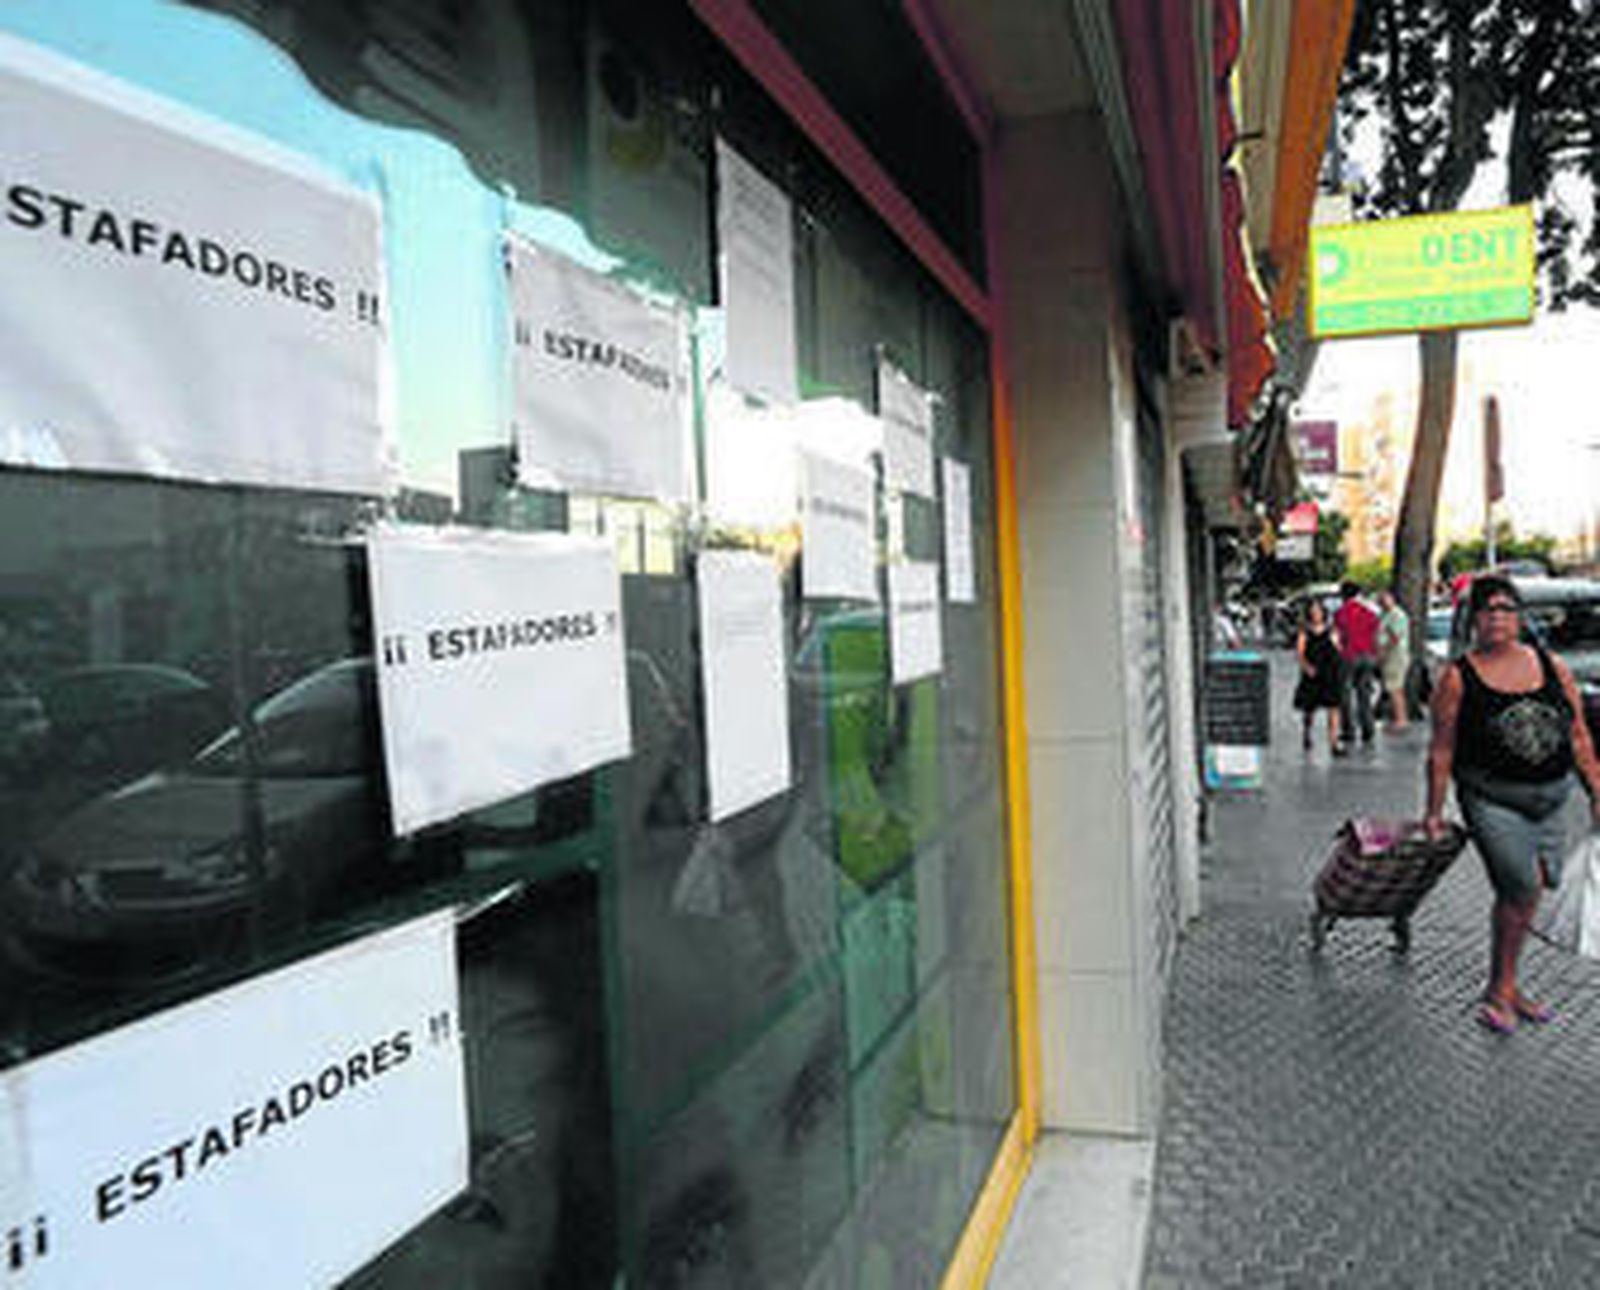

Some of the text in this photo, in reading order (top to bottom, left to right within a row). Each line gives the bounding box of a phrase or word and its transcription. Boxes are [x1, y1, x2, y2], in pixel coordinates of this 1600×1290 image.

[6, 184, 379, 325] STAFADORES !!
[427, 611, 598, 661] ESTAFADORES
[95, 1030, 413, 1224] ESTAFADORES
